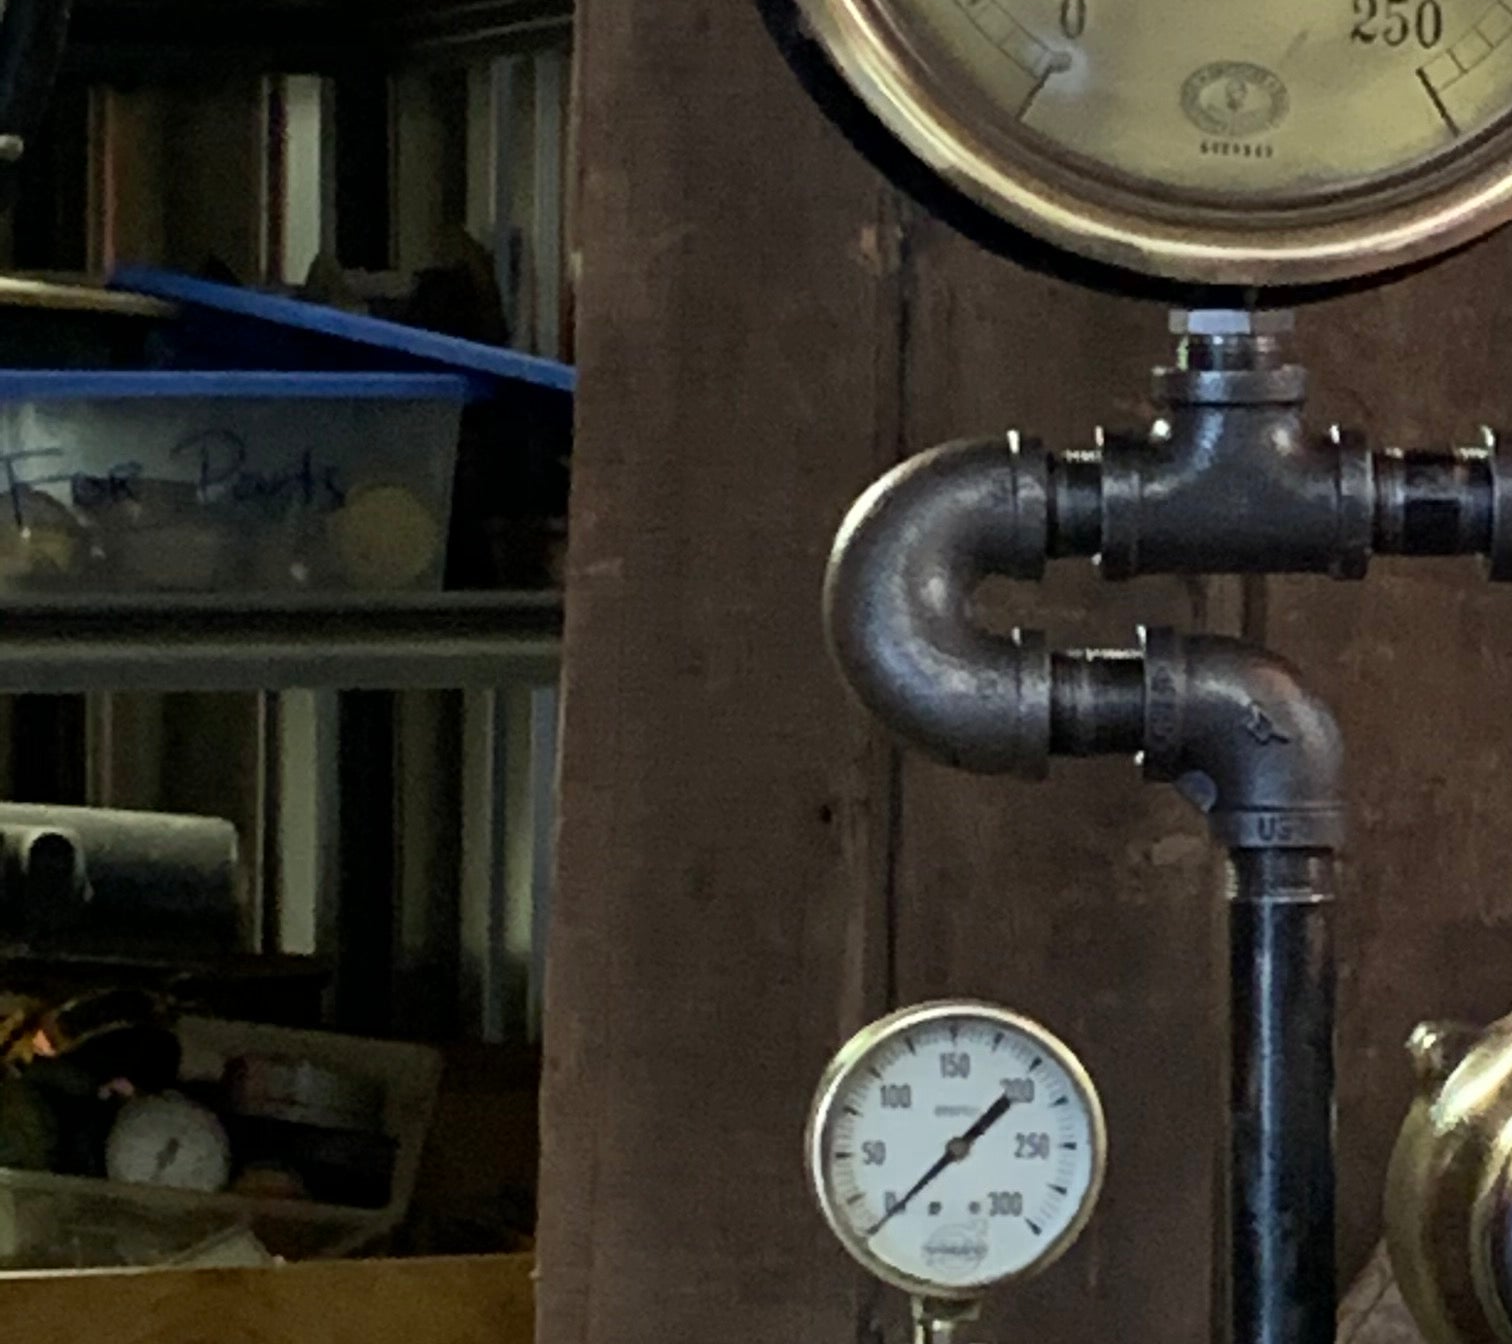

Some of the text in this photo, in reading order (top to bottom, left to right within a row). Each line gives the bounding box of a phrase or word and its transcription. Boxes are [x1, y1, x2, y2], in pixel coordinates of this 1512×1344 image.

[939, 1053, 971, 1079] 150
[880, 1084, 912, 1109] 100
[1000, 1078, 1035, 1104] 200
[861, 1141, 887, 1166] 50
[1014, 1132, 1050, 1160] 250
[987, 1191, 1023, 1218] 300
